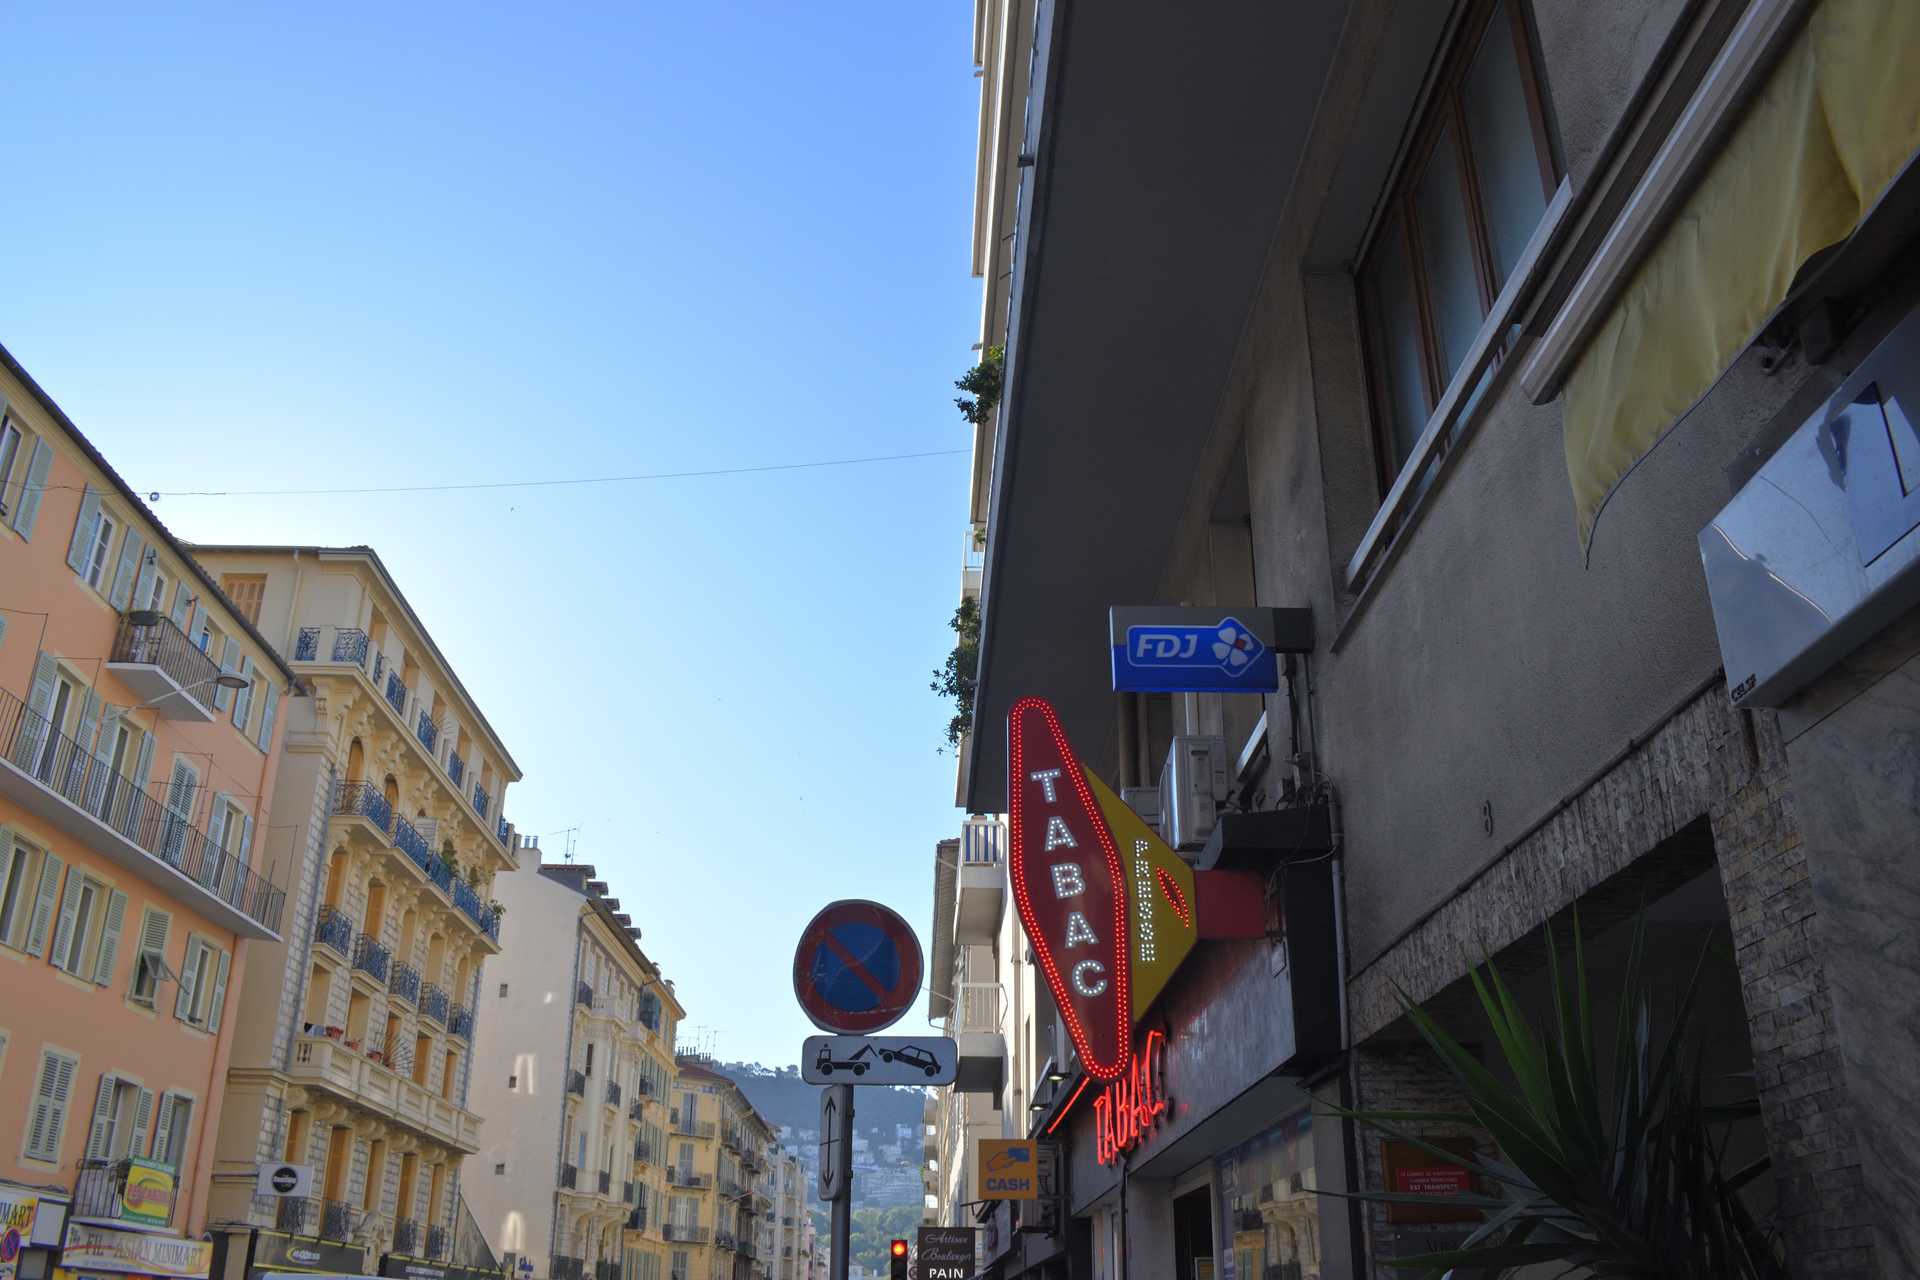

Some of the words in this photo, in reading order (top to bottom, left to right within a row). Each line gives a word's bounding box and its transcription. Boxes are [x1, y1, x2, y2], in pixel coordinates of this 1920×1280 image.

[1136, 634, 1198, 658] FDJ
[1030, 768, 1108, 997] TABAC
[1134, 839, 1157, 962] PRESSE
[1093, 1030, 1164, 1166] TABAC
[986, 1177, 1030, 1191] CASH
[929, 1267, 964, 1279] PAIN
